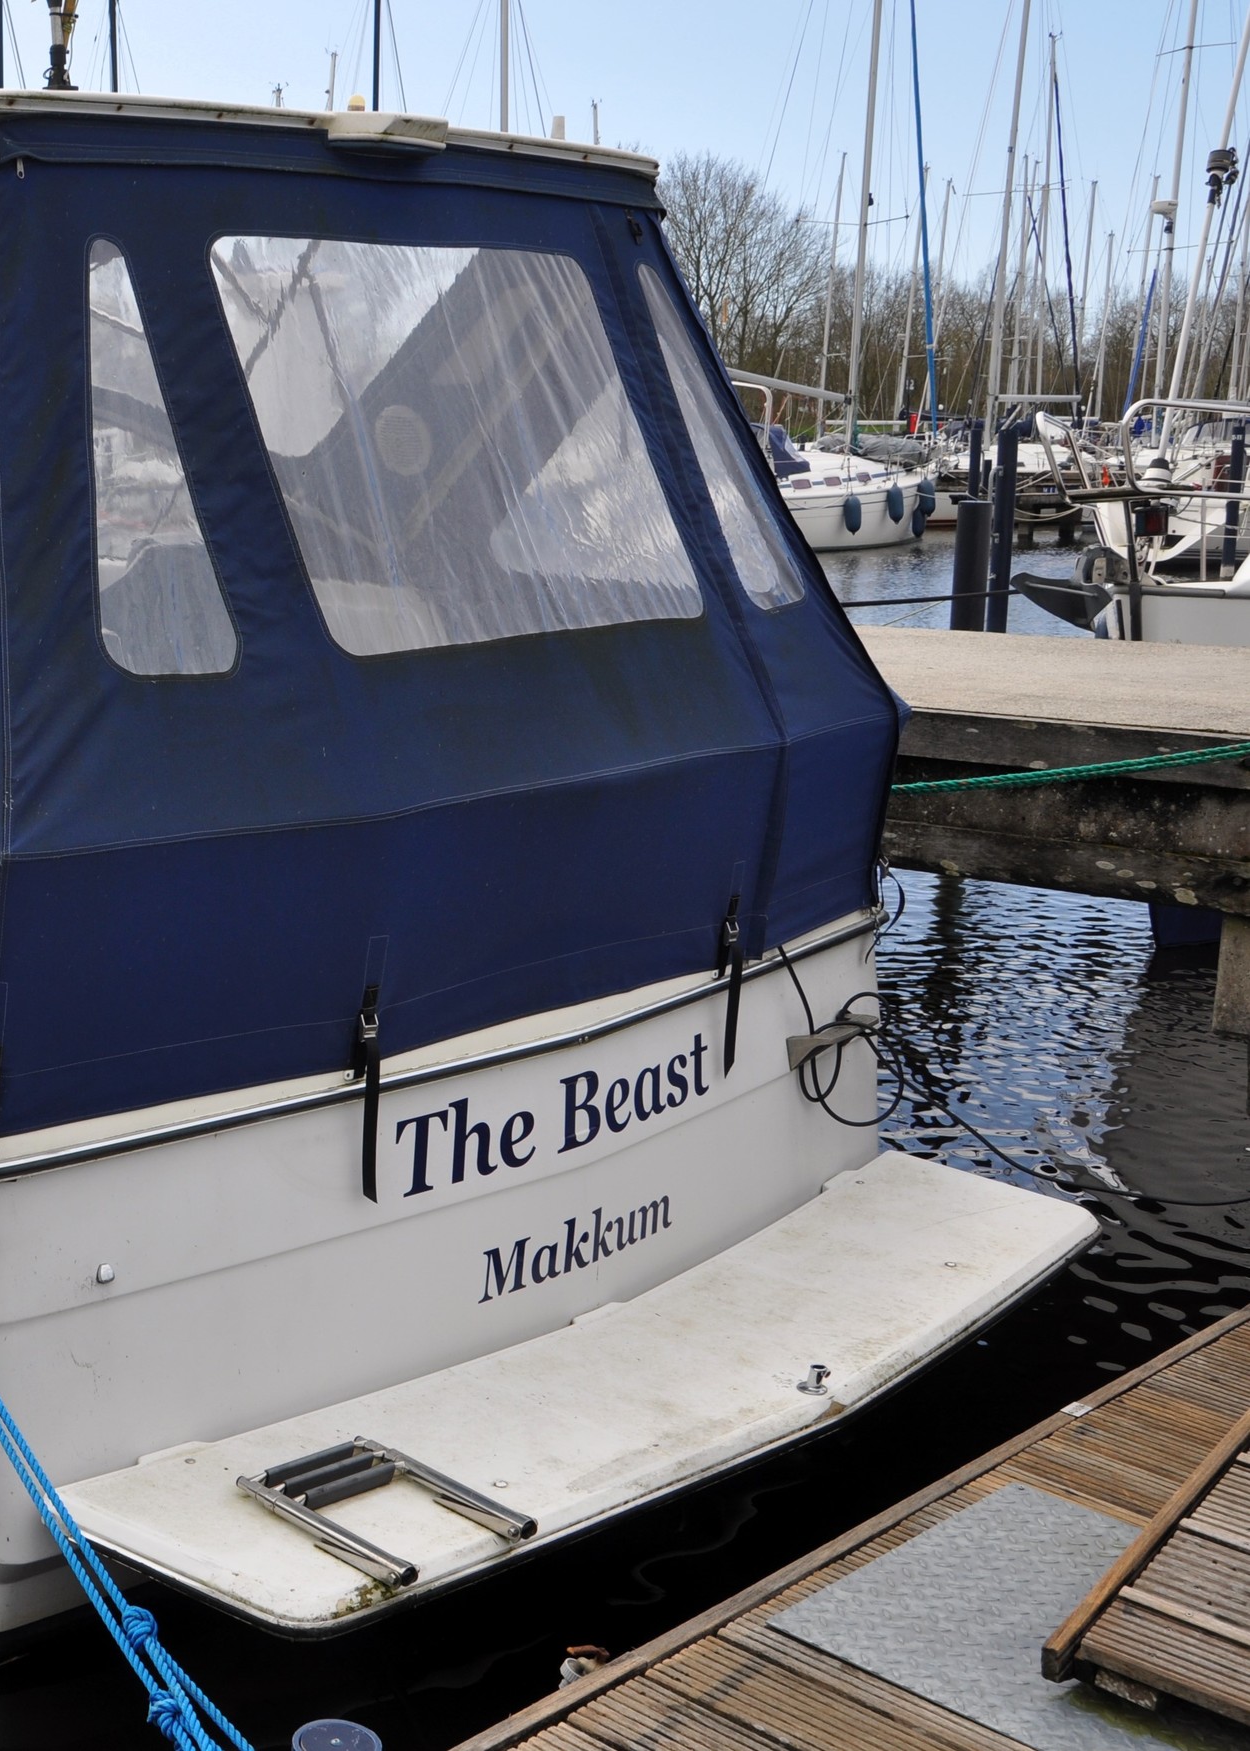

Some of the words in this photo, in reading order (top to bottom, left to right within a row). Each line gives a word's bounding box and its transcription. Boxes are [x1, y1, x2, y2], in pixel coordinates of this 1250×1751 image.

[395, 1097, 537, 1198] The
[557, 1032, 710, 1155] Beast
[477, 1195, 672, 1304] Makkum
